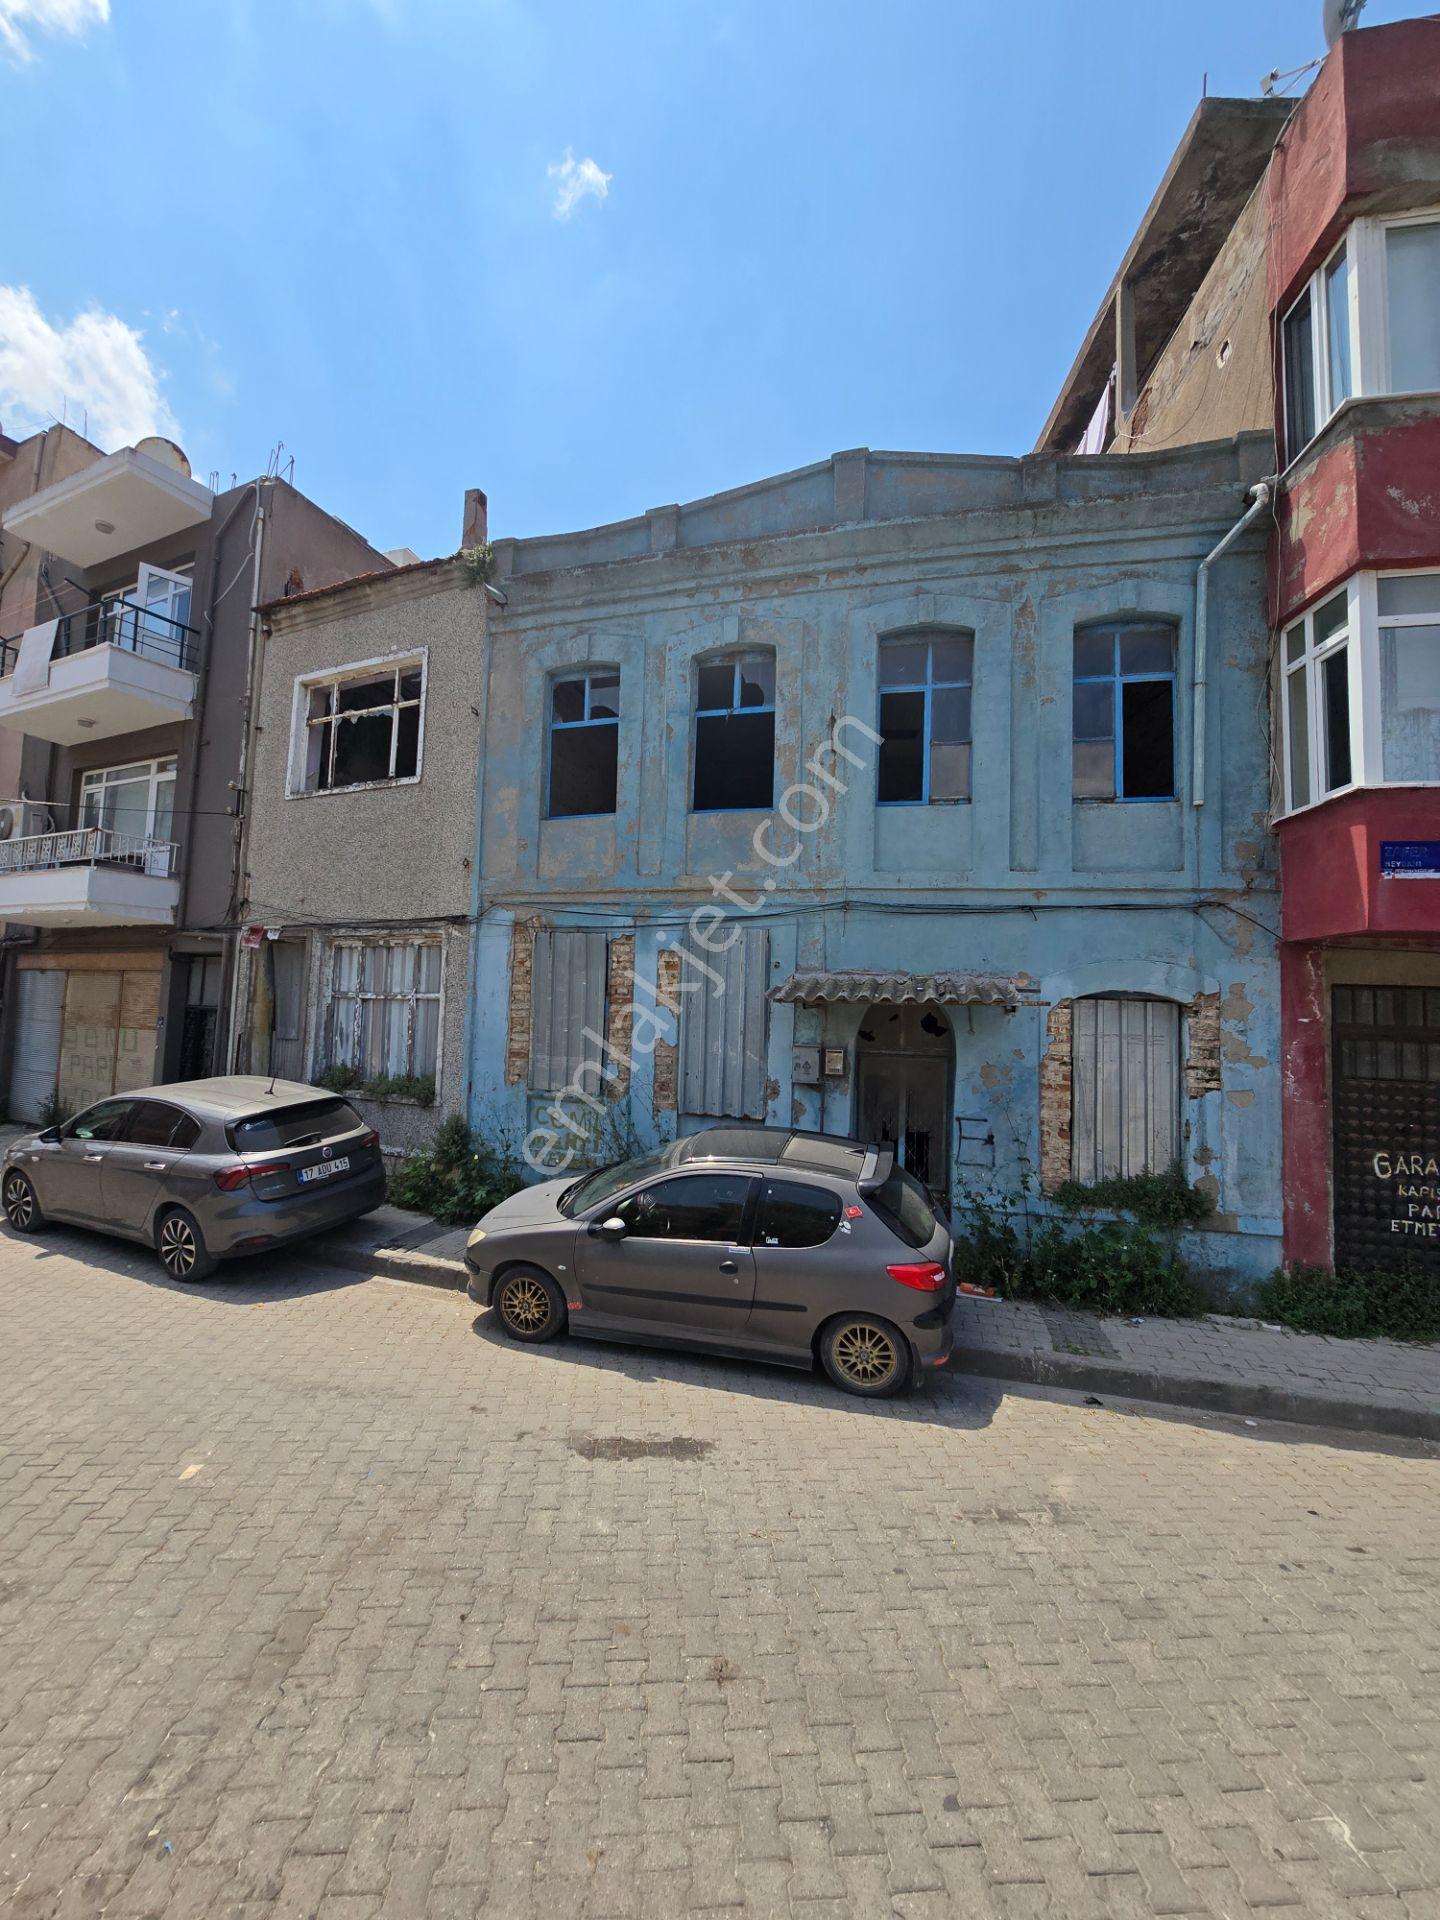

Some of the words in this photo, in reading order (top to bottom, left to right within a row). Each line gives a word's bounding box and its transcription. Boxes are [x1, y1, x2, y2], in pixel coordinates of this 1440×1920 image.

[303, 1168, 314, 1180] 17
[334, 1158, 349, 1170] 415
[1373, 1152, 1440, 1179] GARA
[1391, 1219, 1440, 1237] ETME
